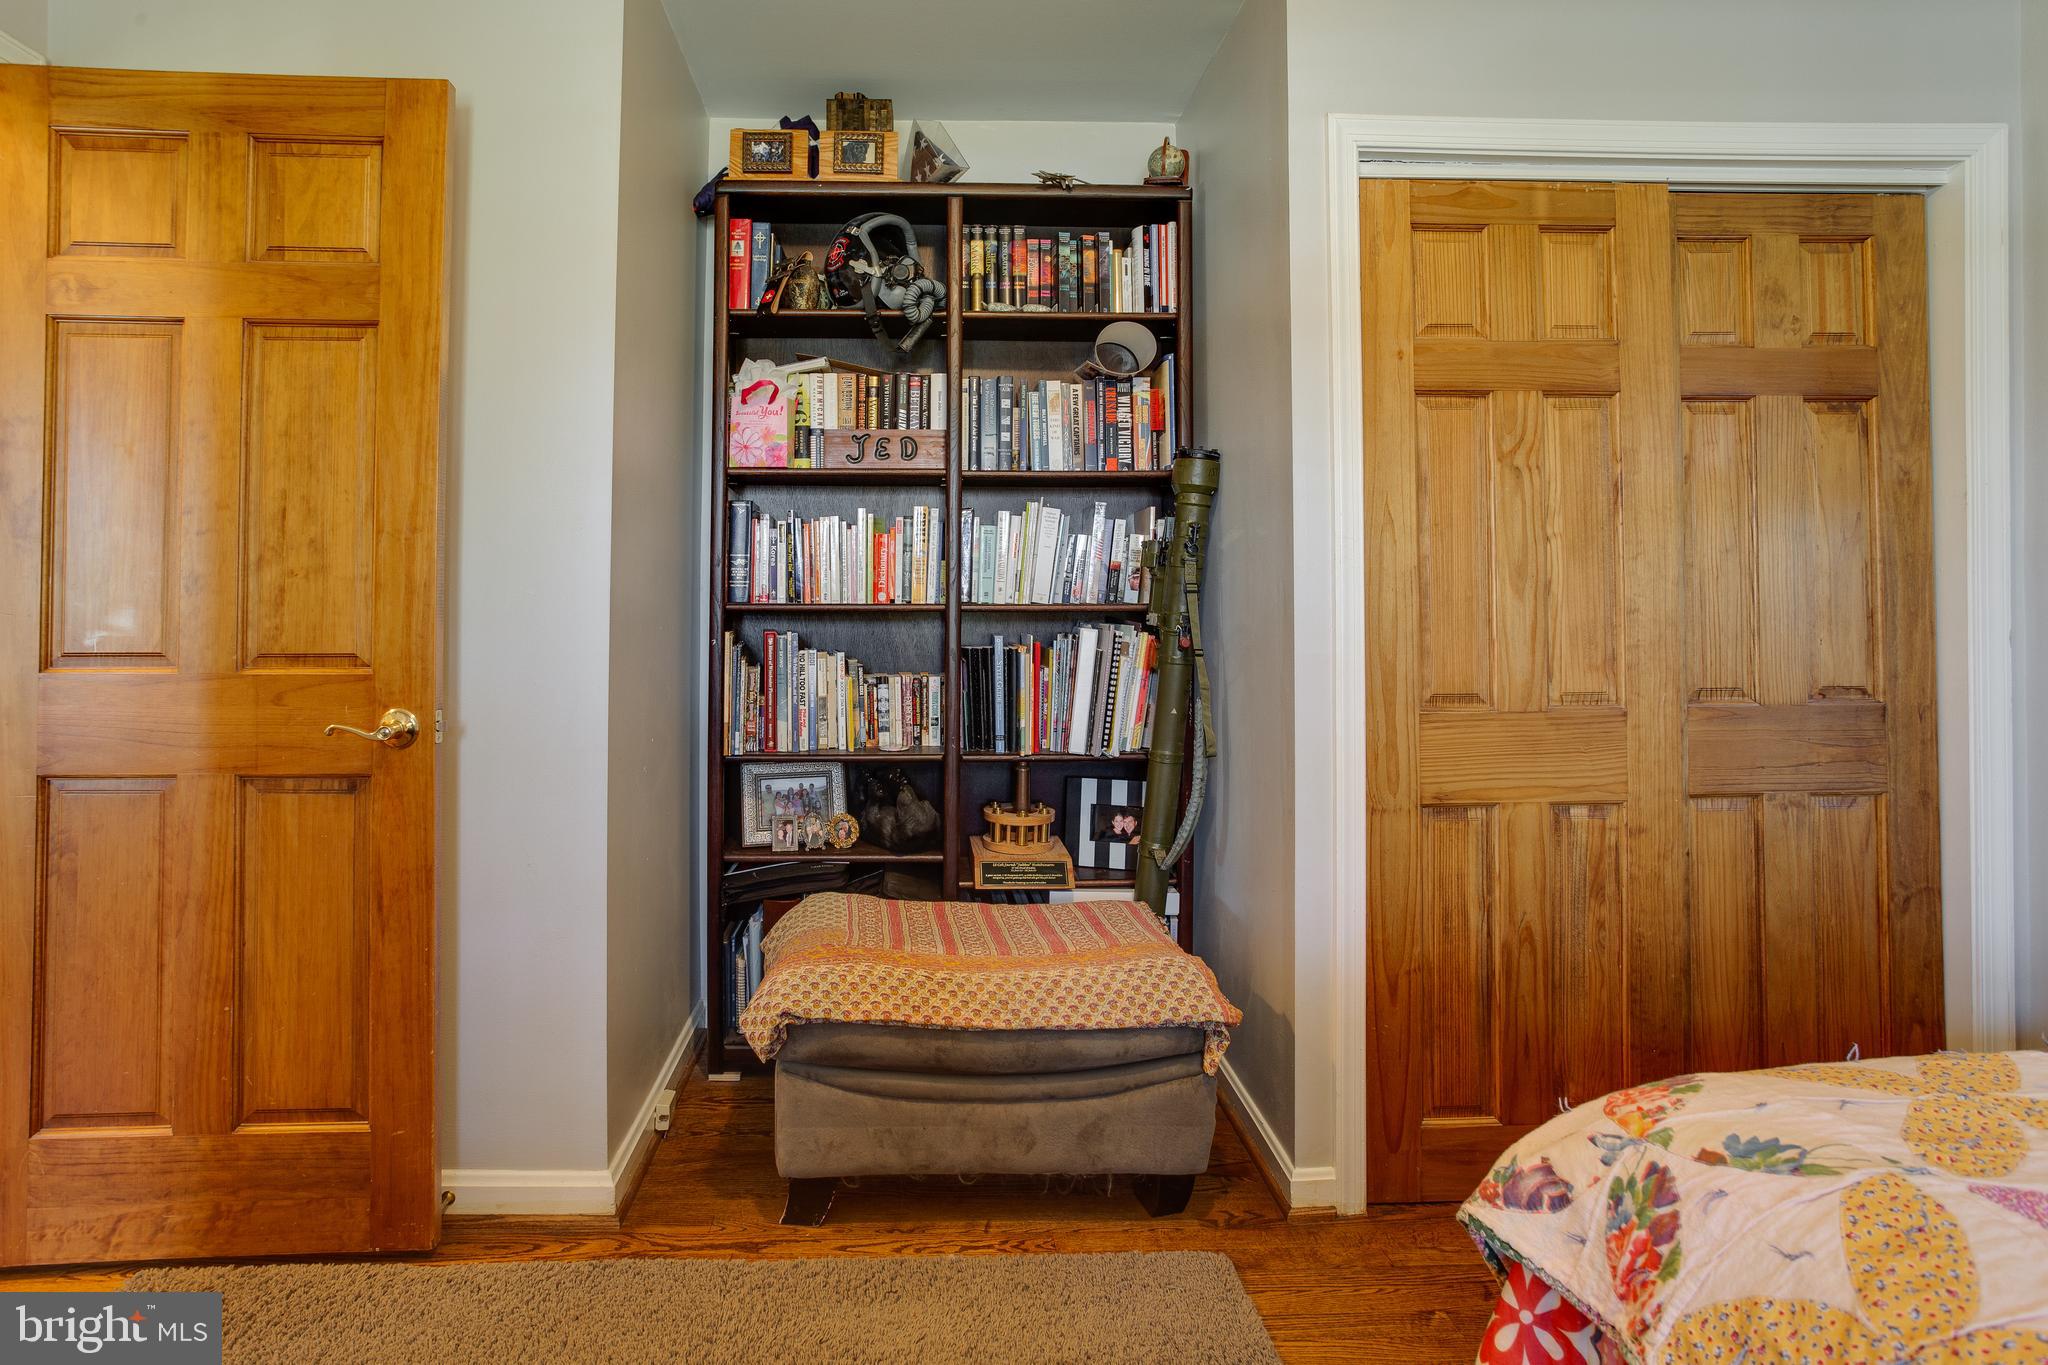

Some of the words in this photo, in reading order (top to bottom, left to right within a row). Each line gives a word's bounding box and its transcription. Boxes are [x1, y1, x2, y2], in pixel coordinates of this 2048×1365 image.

[758, 405, 784, 420] You!
[842, 391, 852, 410] BROWN
[1106, 387, 1117, 424] CRUSADE
[1118, 396, 1131, 428] WINGED
[846, 434, 918, 464] JED
[1118, 430, 1132, 464] VICTORY
[878, 546, 888, 588] Dictionary
[800, 653, 805, 662] NO
